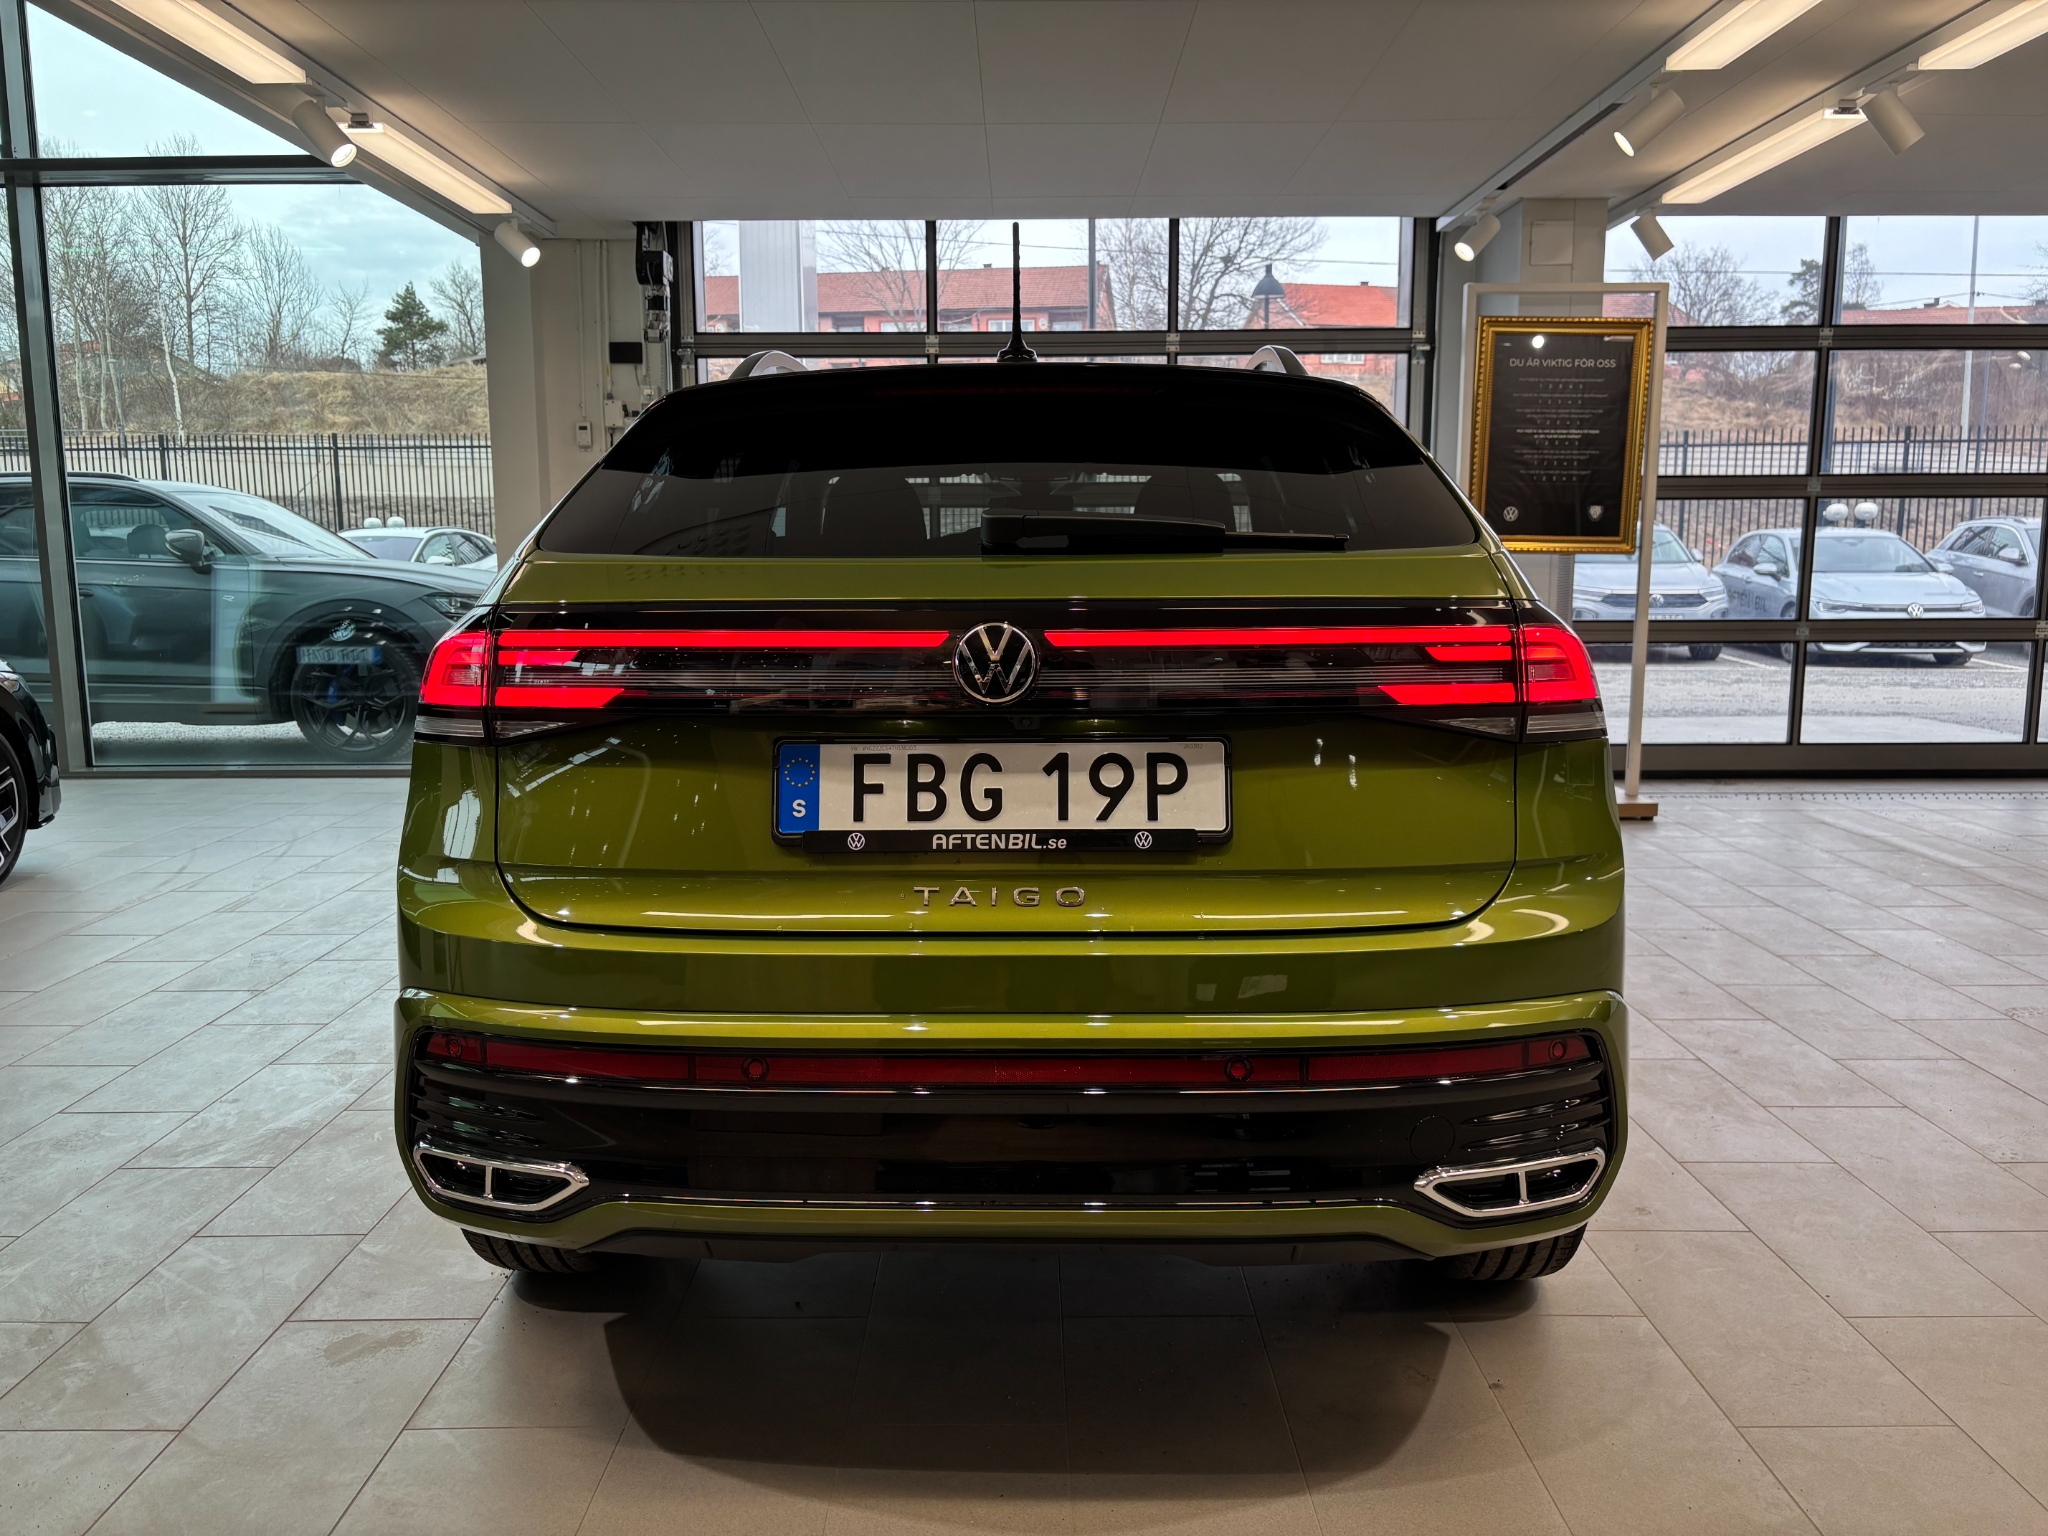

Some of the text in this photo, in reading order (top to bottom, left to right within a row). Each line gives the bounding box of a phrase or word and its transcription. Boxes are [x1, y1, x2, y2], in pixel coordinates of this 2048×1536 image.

[1509, 357, 1617, 368] DU ÄR VIKTIG FÖR OSS
[853, 752, 1189, 823] FBG 19P
[792, 799, 806, 818] S
[932, 833, 1067, 850] AFTENBIL.se
[913, 886, 1086, 908] TAIGO
